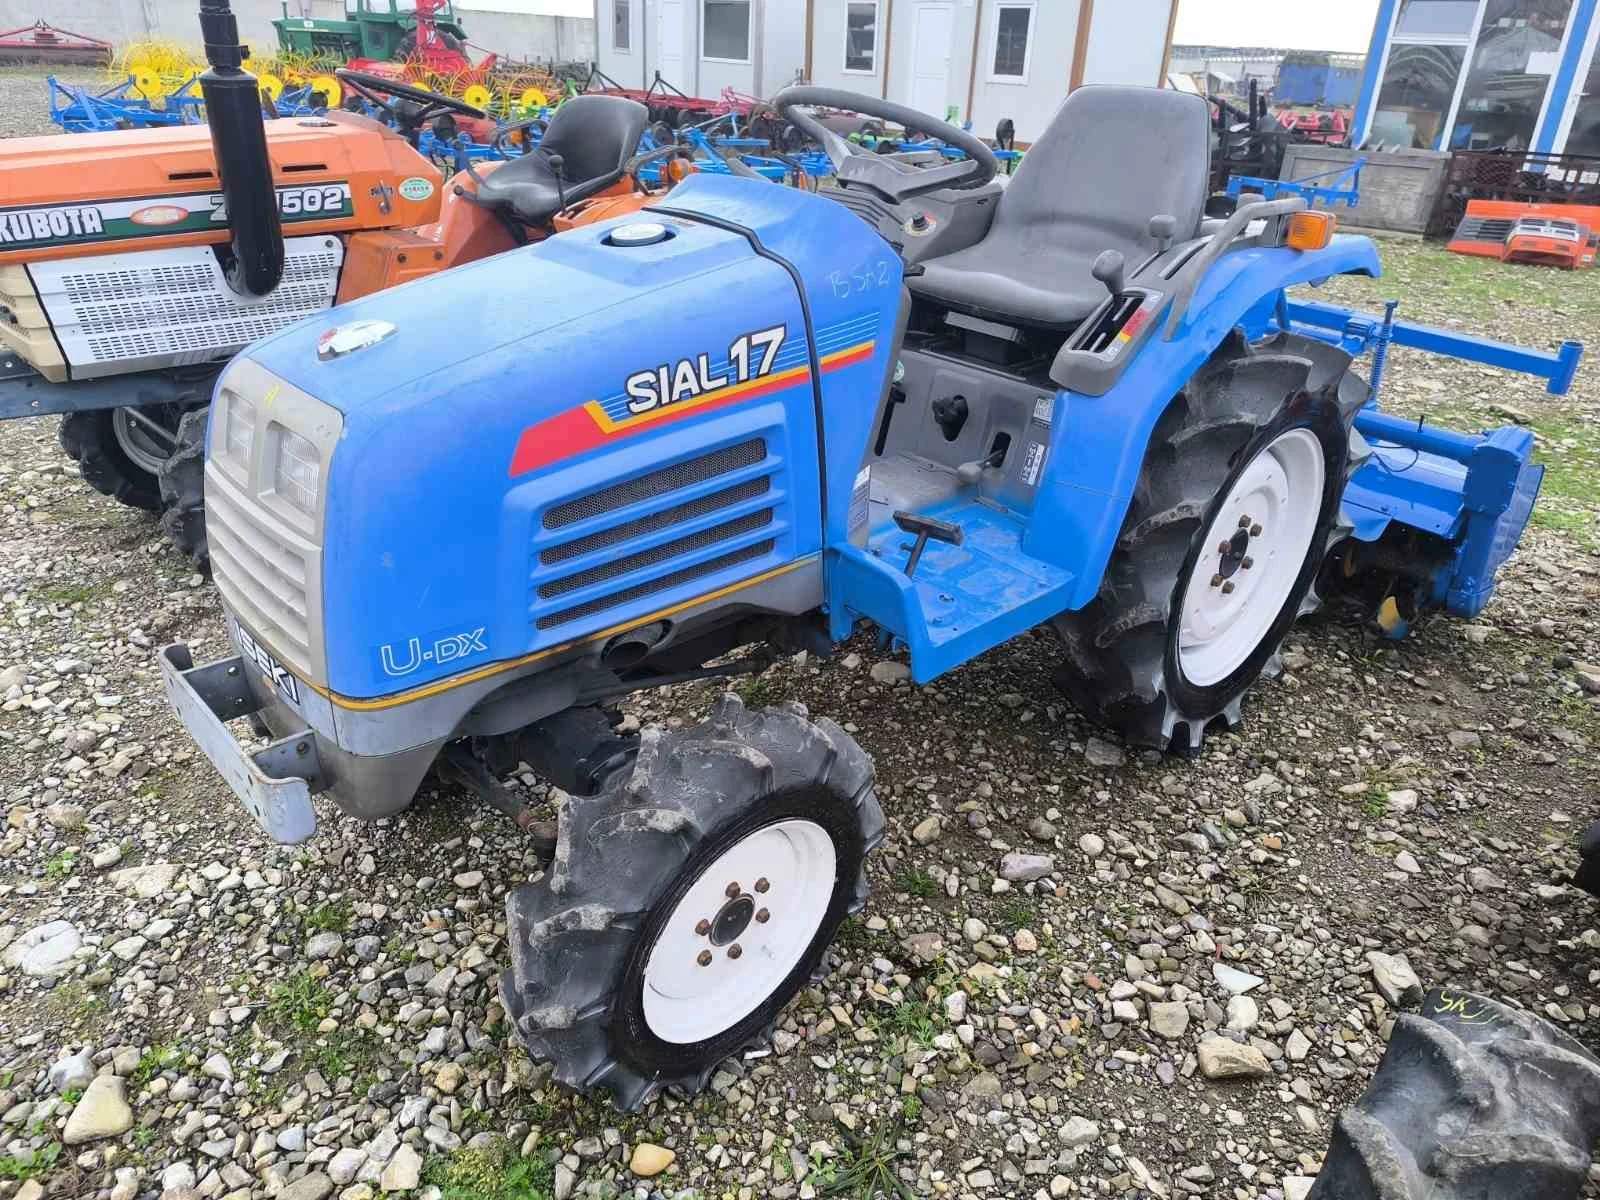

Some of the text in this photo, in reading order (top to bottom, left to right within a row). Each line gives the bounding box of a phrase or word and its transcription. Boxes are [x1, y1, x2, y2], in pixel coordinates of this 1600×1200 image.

[0, 207, 103, 243] KUBOTA
[625, 322, 786, 413] SIAL 17
[381, 627, 488, 676] U-DX
